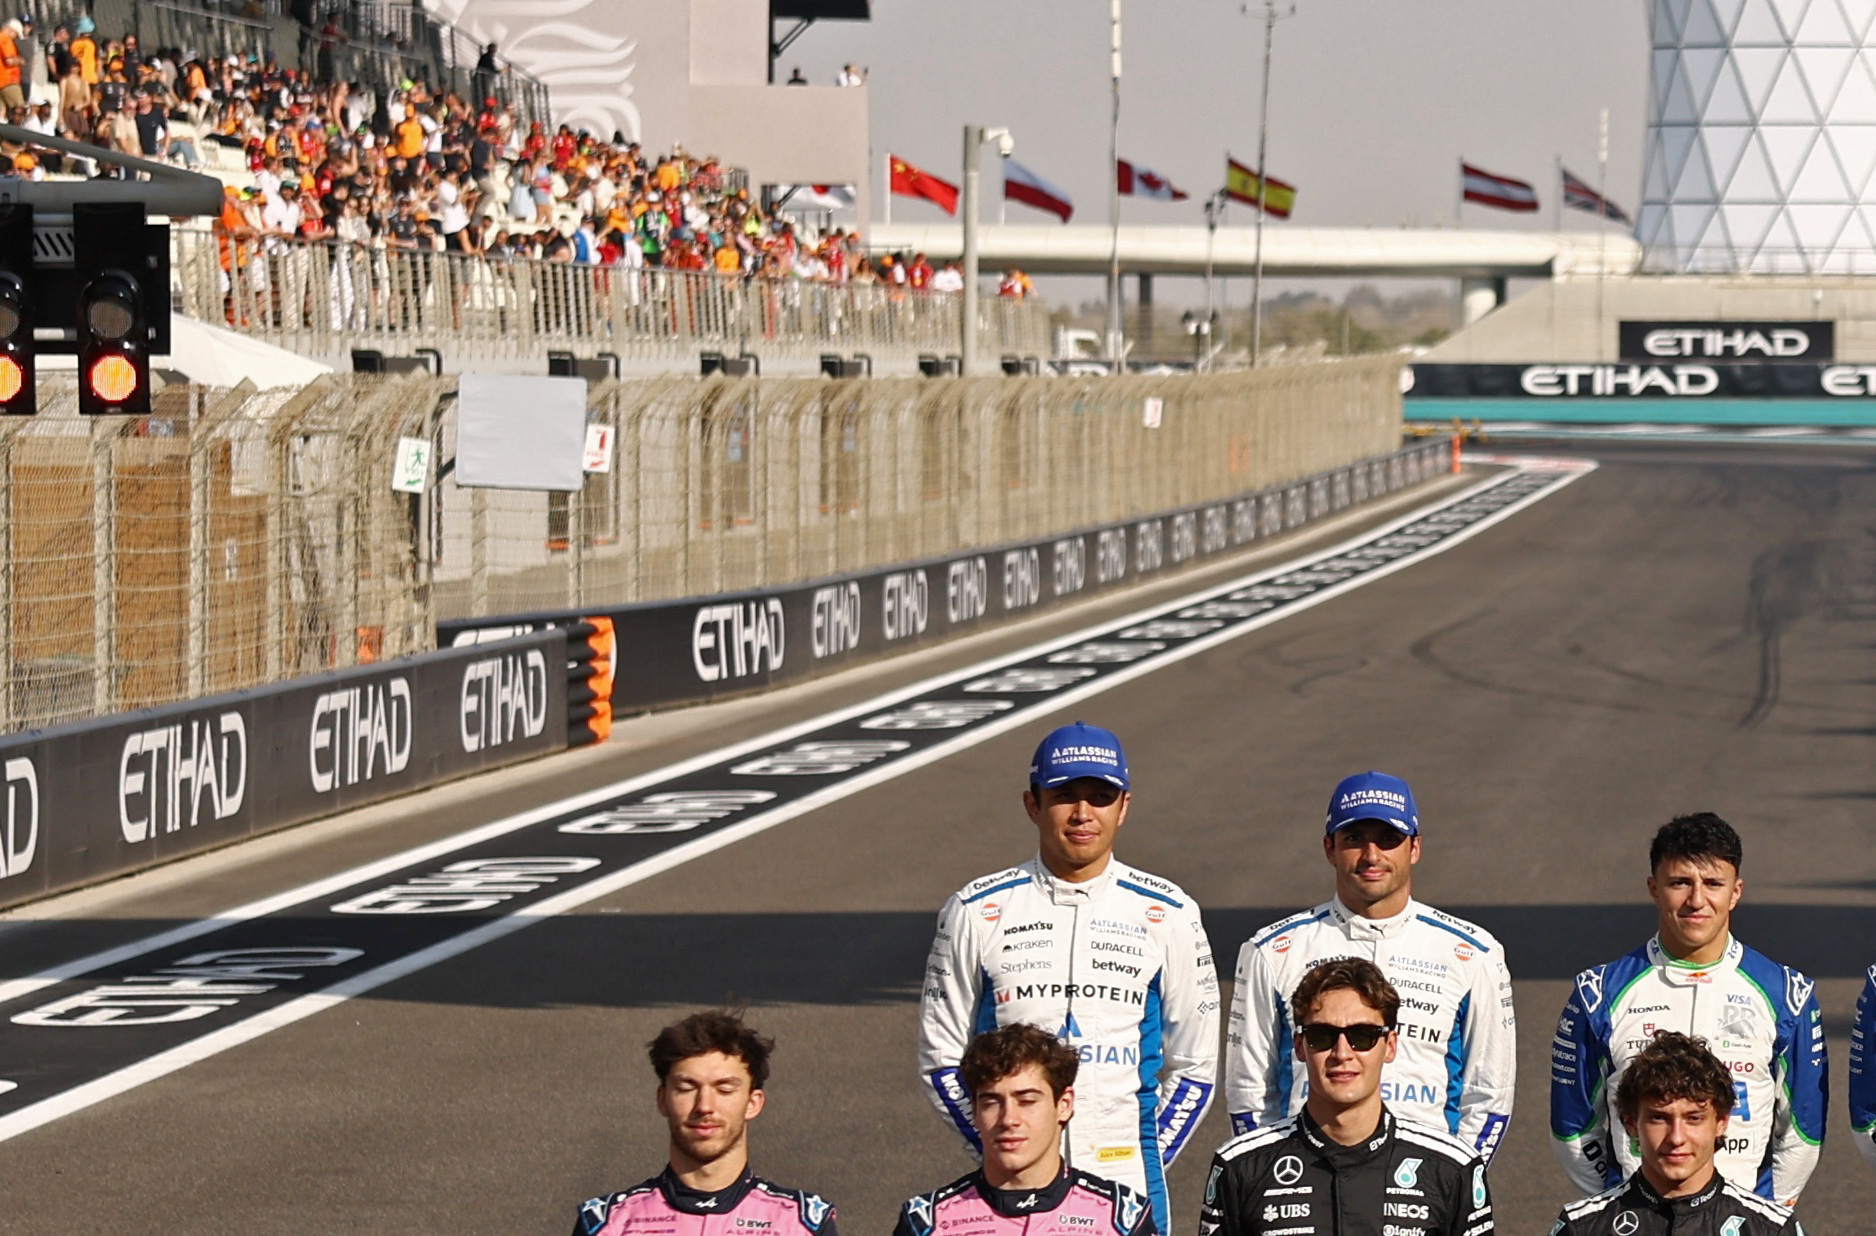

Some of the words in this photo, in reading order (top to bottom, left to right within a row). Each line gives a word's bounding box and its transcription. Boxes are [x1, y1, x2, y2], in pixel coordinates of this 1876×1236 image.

[1644, 329, 1810, 357] ETIHAD
[1520, 364, 1720, 396] ETIHAD
[1003, 547, 1040, 610] ETIHAD
[947, 556, 988, 623] ETIHAD
[882, 568, 929, 641] ETIHAD
[811, 580, 861, 659] ETIHAD
[692, 597, 786, 682] ETIHAD
[460, 648, 547, 754] ETIHAD
[309, 677, 413, 793] ETIHAD
[1051, 755, 1091, 766] WILLIAMS
[1091, 756, 1118, 767] RACING
[1062, 746, 1117, 758] ATLASSIAN
[119, 711, 247, 844] ETIHAD
[1340, 798, 1378, 811] WILLIAMS
[1378, 798, 1405, 813] RACING
[1350, 789, 1406, 804] ATLASSIAN
[329, 856, 602, 914] ETIHAD
[1128, 871, 1176, 894] betway
[1004, 922, 1053, 936] KOMATSU
[1432, 910, 1478, 935] betway
[1012, 938, 1054, 951] kraken
[1090, 940, 1145, 957] DURACELL
[1001, 960, 1052, 975] Stephens
[1092, 957, 1142, 978] betway
[9, 947, 365, 1026] ETIHAD
[1016, 983, 1144, 1006] MYPROTEIN
[1389, 976, 1443, 995] DURACELL
[1628, 1004, 1671, 1014] HONDA
[1726, 993, 1752, 1006] VISA
[1386, 1187, 1425, 1197] PETRONAS
[1280, 1203, 1311, 1218] UBS
[1383, 1202, 1430, 1220] INEOS
[746, 1220, 772, 1229] BWT
[951, 1215, 995, 1226] BINANCE
[1069, 1216, 1096, 1226] BWT
